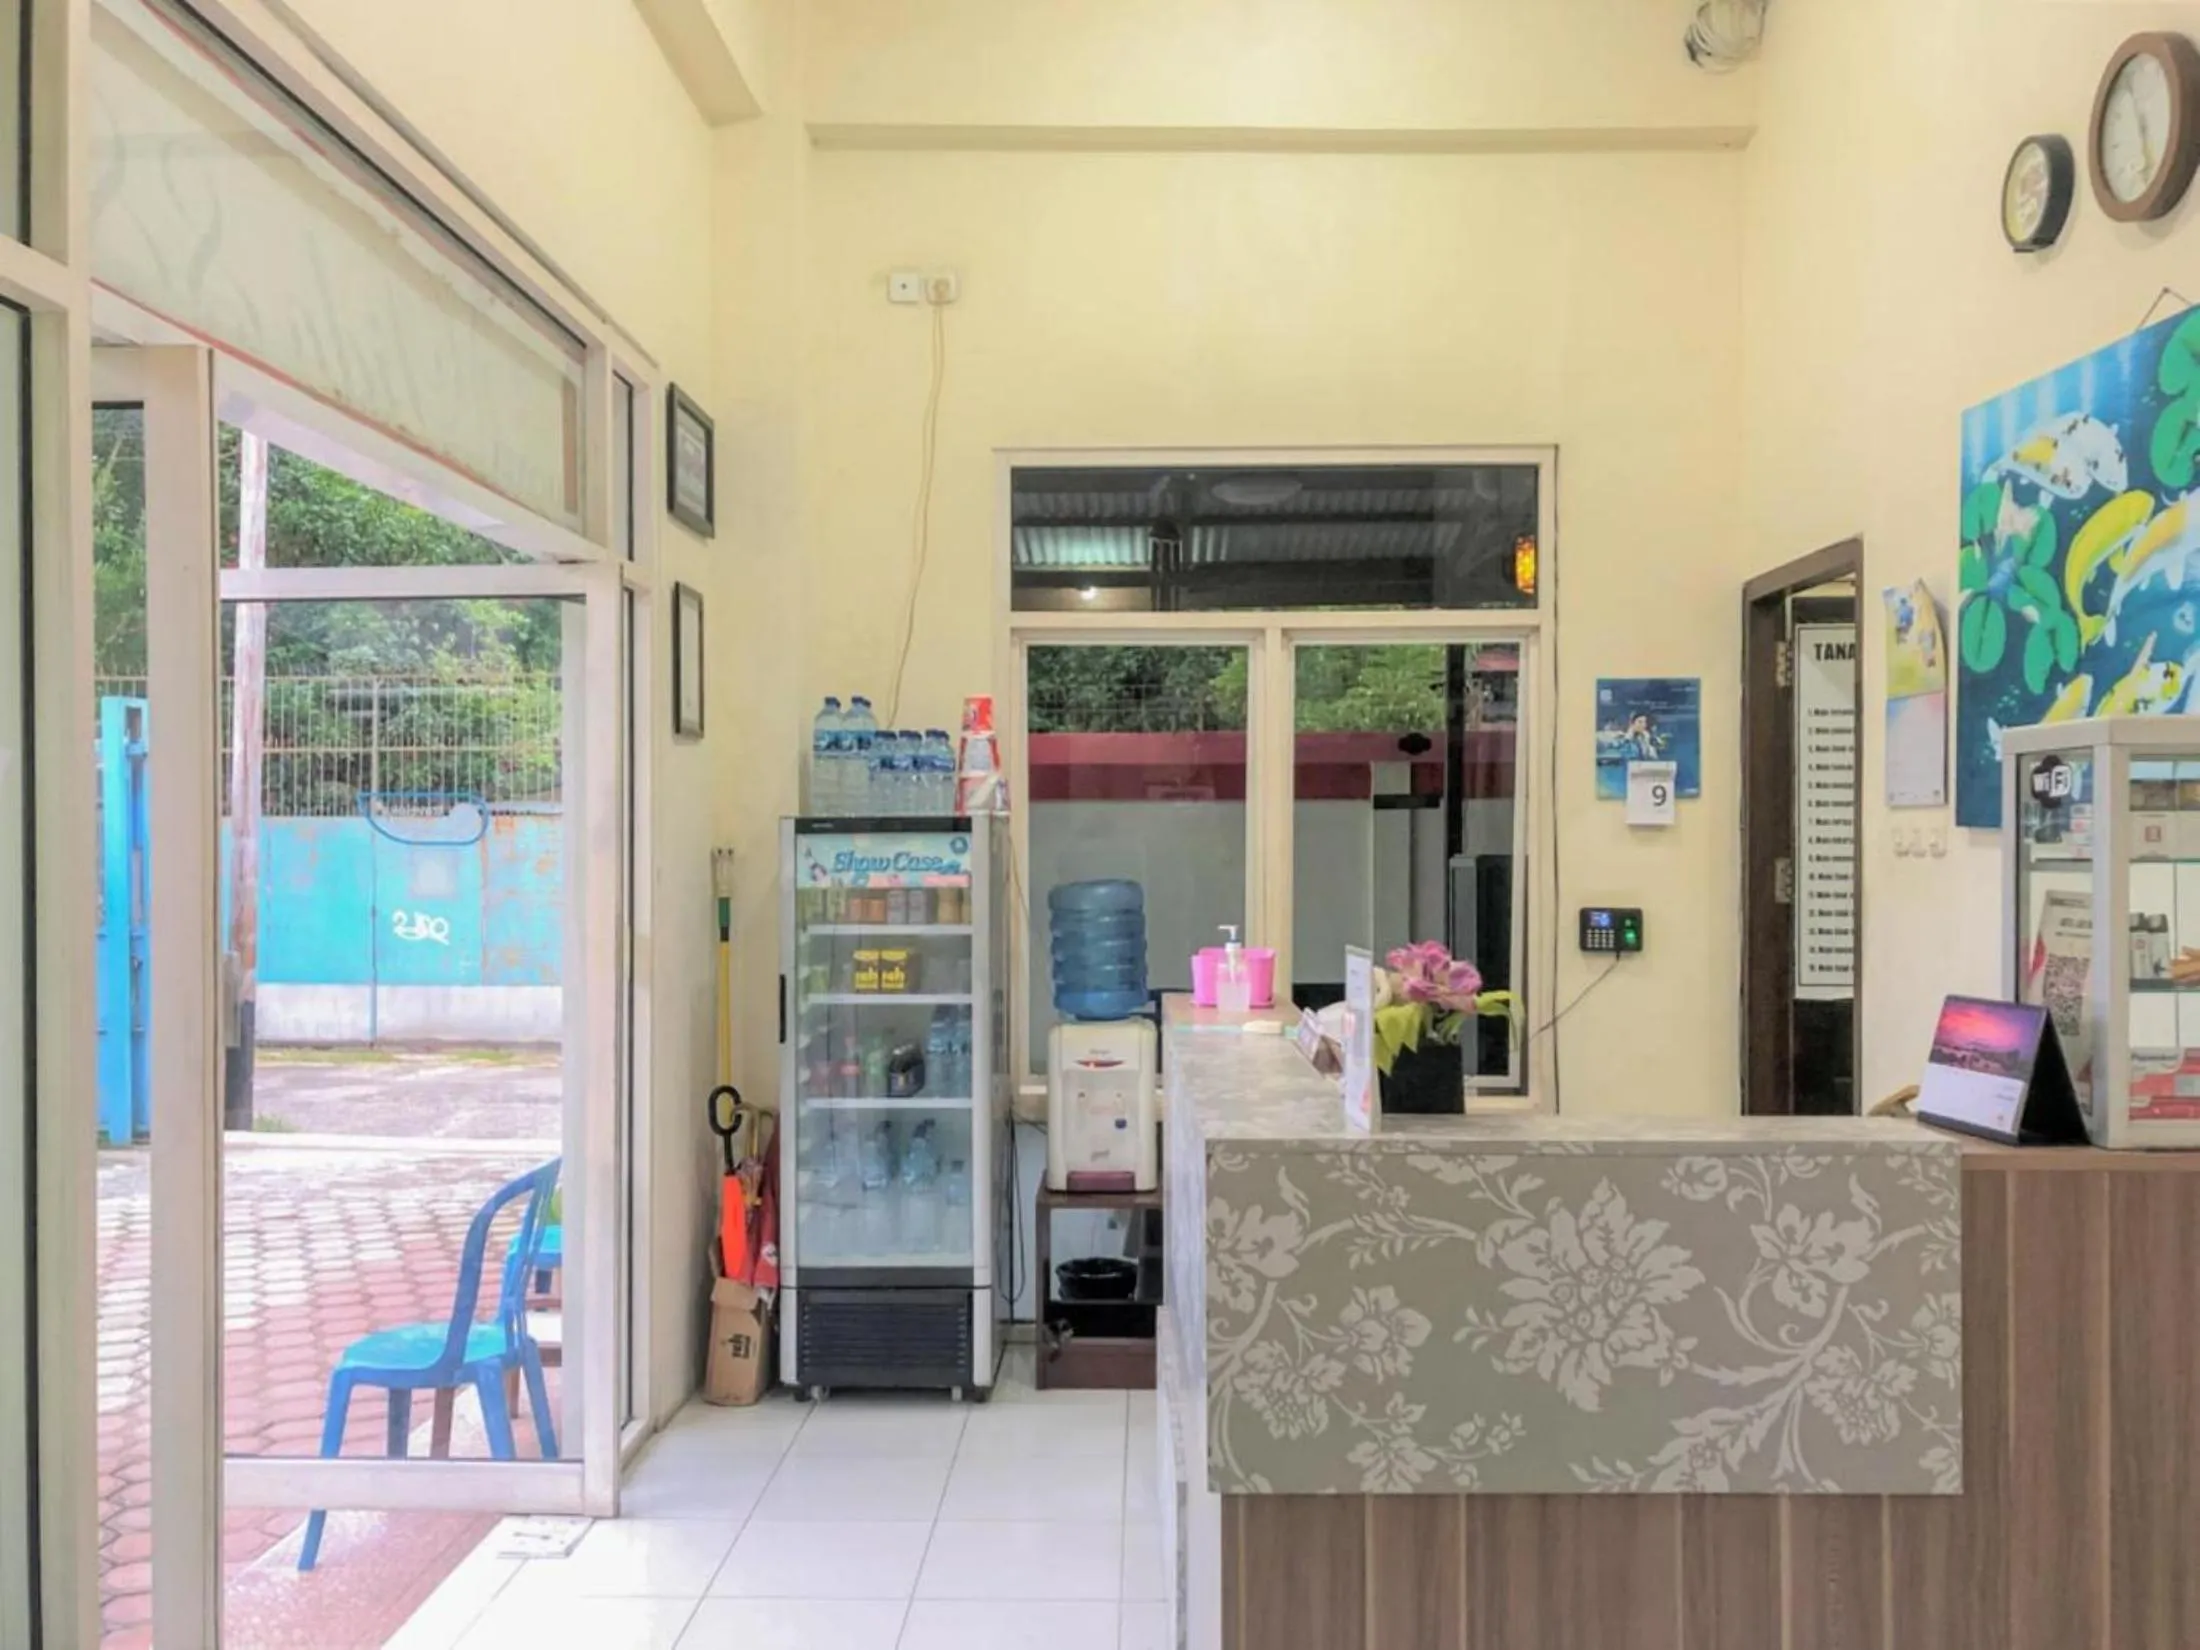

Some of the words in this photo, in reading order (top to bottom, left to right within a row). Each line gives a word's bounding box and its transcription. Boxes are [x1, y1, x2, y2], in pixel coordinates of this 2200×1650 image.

[1652, 785, 1667, 807] 9
[834, 851, 890, 873] Show
[893, 851, 943, 872] Case
